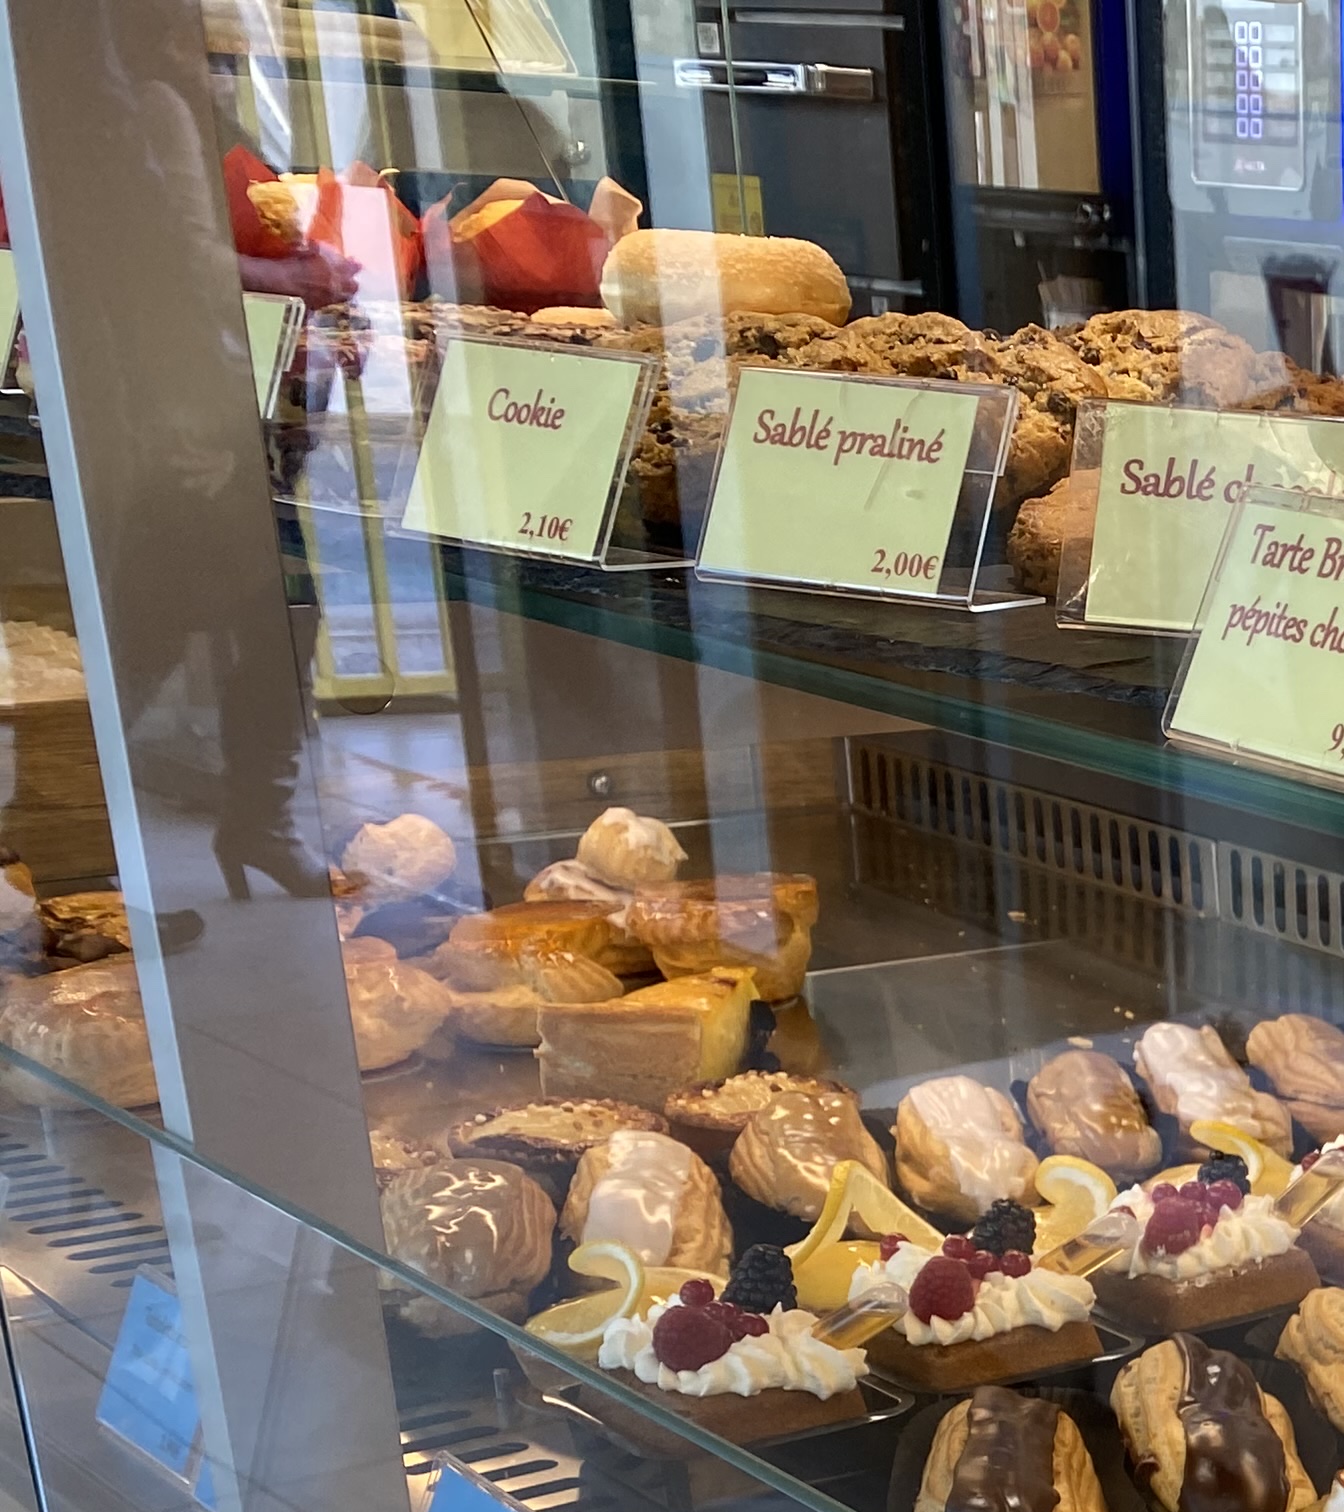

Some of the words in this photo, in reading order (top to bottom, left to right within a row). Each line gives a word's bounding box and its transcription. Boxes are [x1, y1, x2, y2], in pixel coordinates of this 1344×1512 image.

[486, 387, 566, 431] Cookie
[752, 407, 833, 453] Sablé
[833, 417, 947, 466] praliné
[1119, 457, 1217, 501] Sablé
[518, 511, 574, 543] 2,10€
[870, 548, 940, 582] 2,00€
[1249, 523, 1314, 576] Tarte
[1221, 595, 1309, 646] pépites
